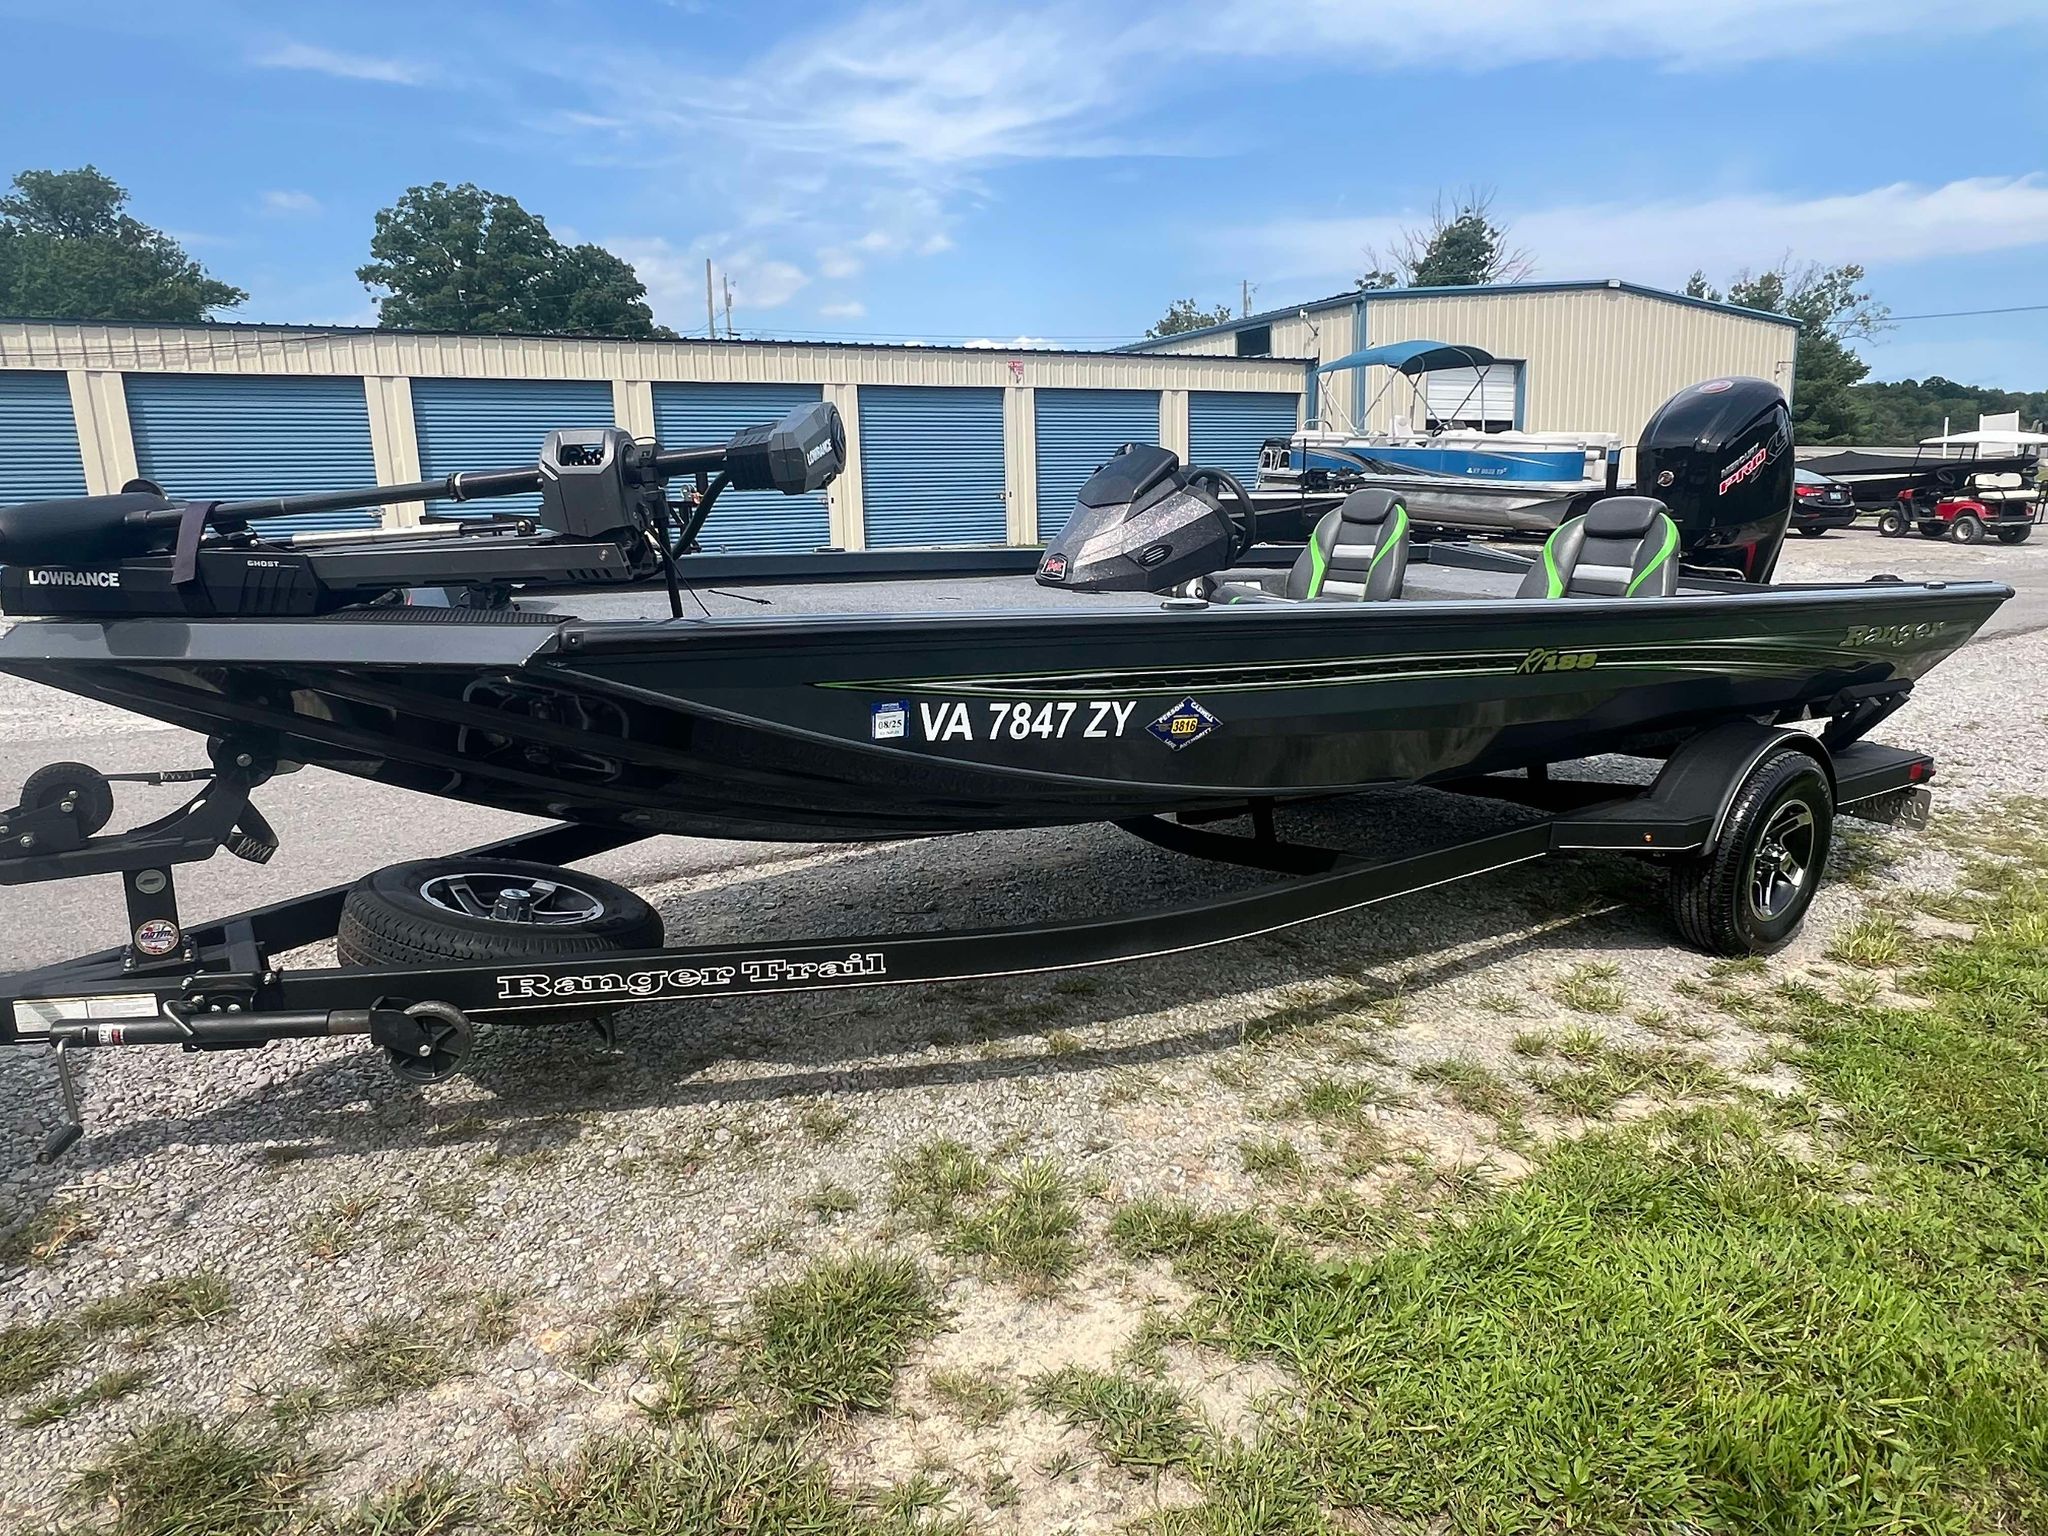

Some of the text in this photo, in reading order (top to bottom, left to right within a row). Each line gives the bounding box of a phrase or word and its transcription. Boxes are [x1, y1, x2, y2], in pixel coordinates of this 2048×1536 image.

[806, 438, 832, 466] LOWRANCE
[1719, 447, 1767, 496] PRO
[28, 570, 120, 587] LOWRANCE
[1839, 622, 1944, 647] Ranger
[878, 719, 903, 731] 08/25
[920, 700, 1138, 742] VA 7847 ZY
[1158, 702, 1185, 723] PERSON
[1172, 720, 1197, 732] 3816
[496, 953, 887, 999] Ranger Trail
